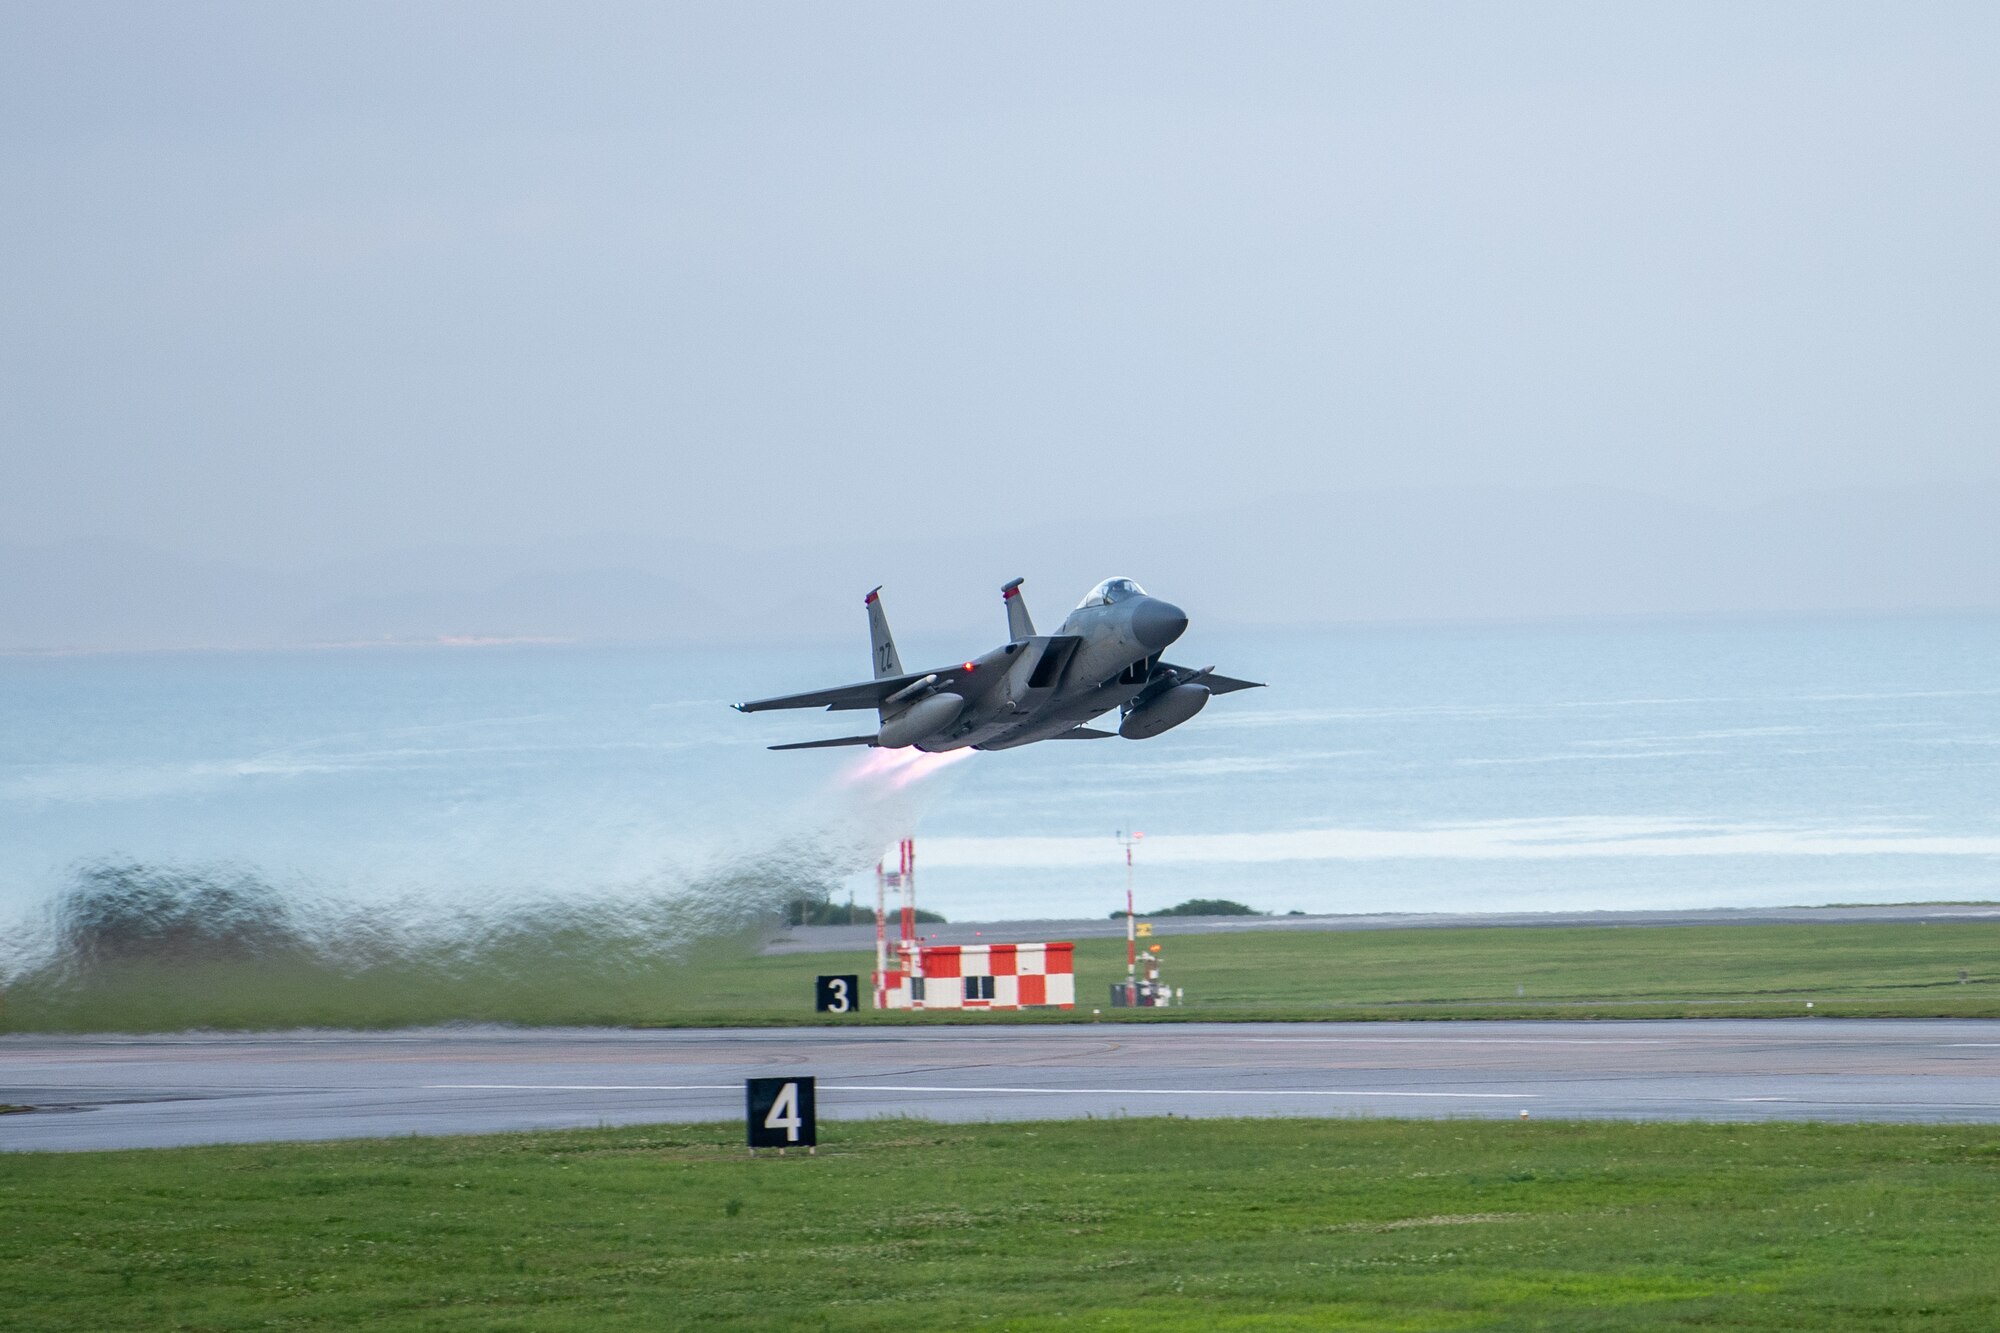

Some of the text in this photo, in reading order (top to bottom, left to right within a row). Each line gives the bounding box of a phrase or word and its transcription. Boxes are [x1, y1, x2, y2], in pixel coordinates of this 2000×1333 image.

[879, 642, 893, 672] ZZ
[828, 978, 849, 1013] 3
[764, 1082, 802, 1141] 4
